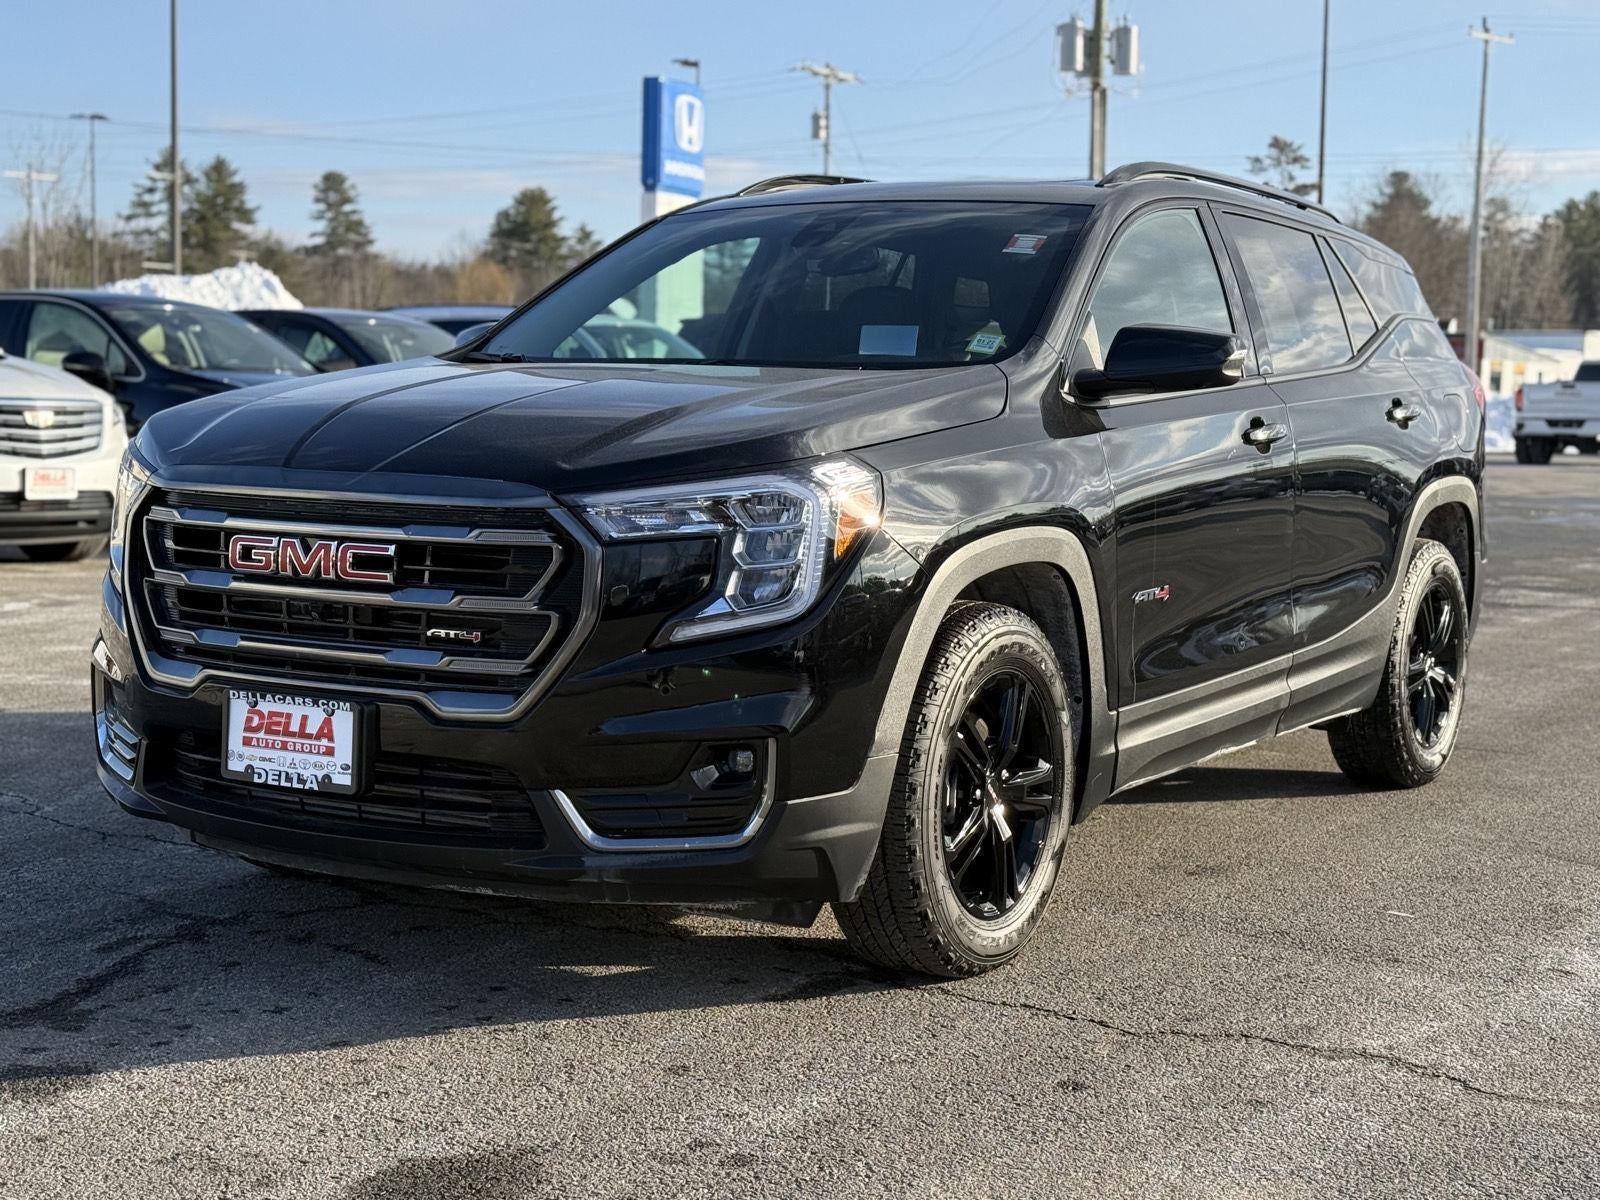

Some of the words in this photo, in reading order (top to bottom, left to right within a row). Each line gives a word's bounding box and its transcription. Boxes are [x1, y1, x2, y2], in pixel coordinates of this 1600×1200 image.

[229, 535, 395, 584] GMC
[1132, 585, 1169, 605] AT4
[427, 629, 481, 643] AT4
[229, 689, 351, 712] DELLACARS.COM
[242, 708, 335, 743] DELLA
[251, 738, 281, 749] AUTO
[287, 741, 327, 754] GROUP
[253, 767, 319, 791] DELLA
